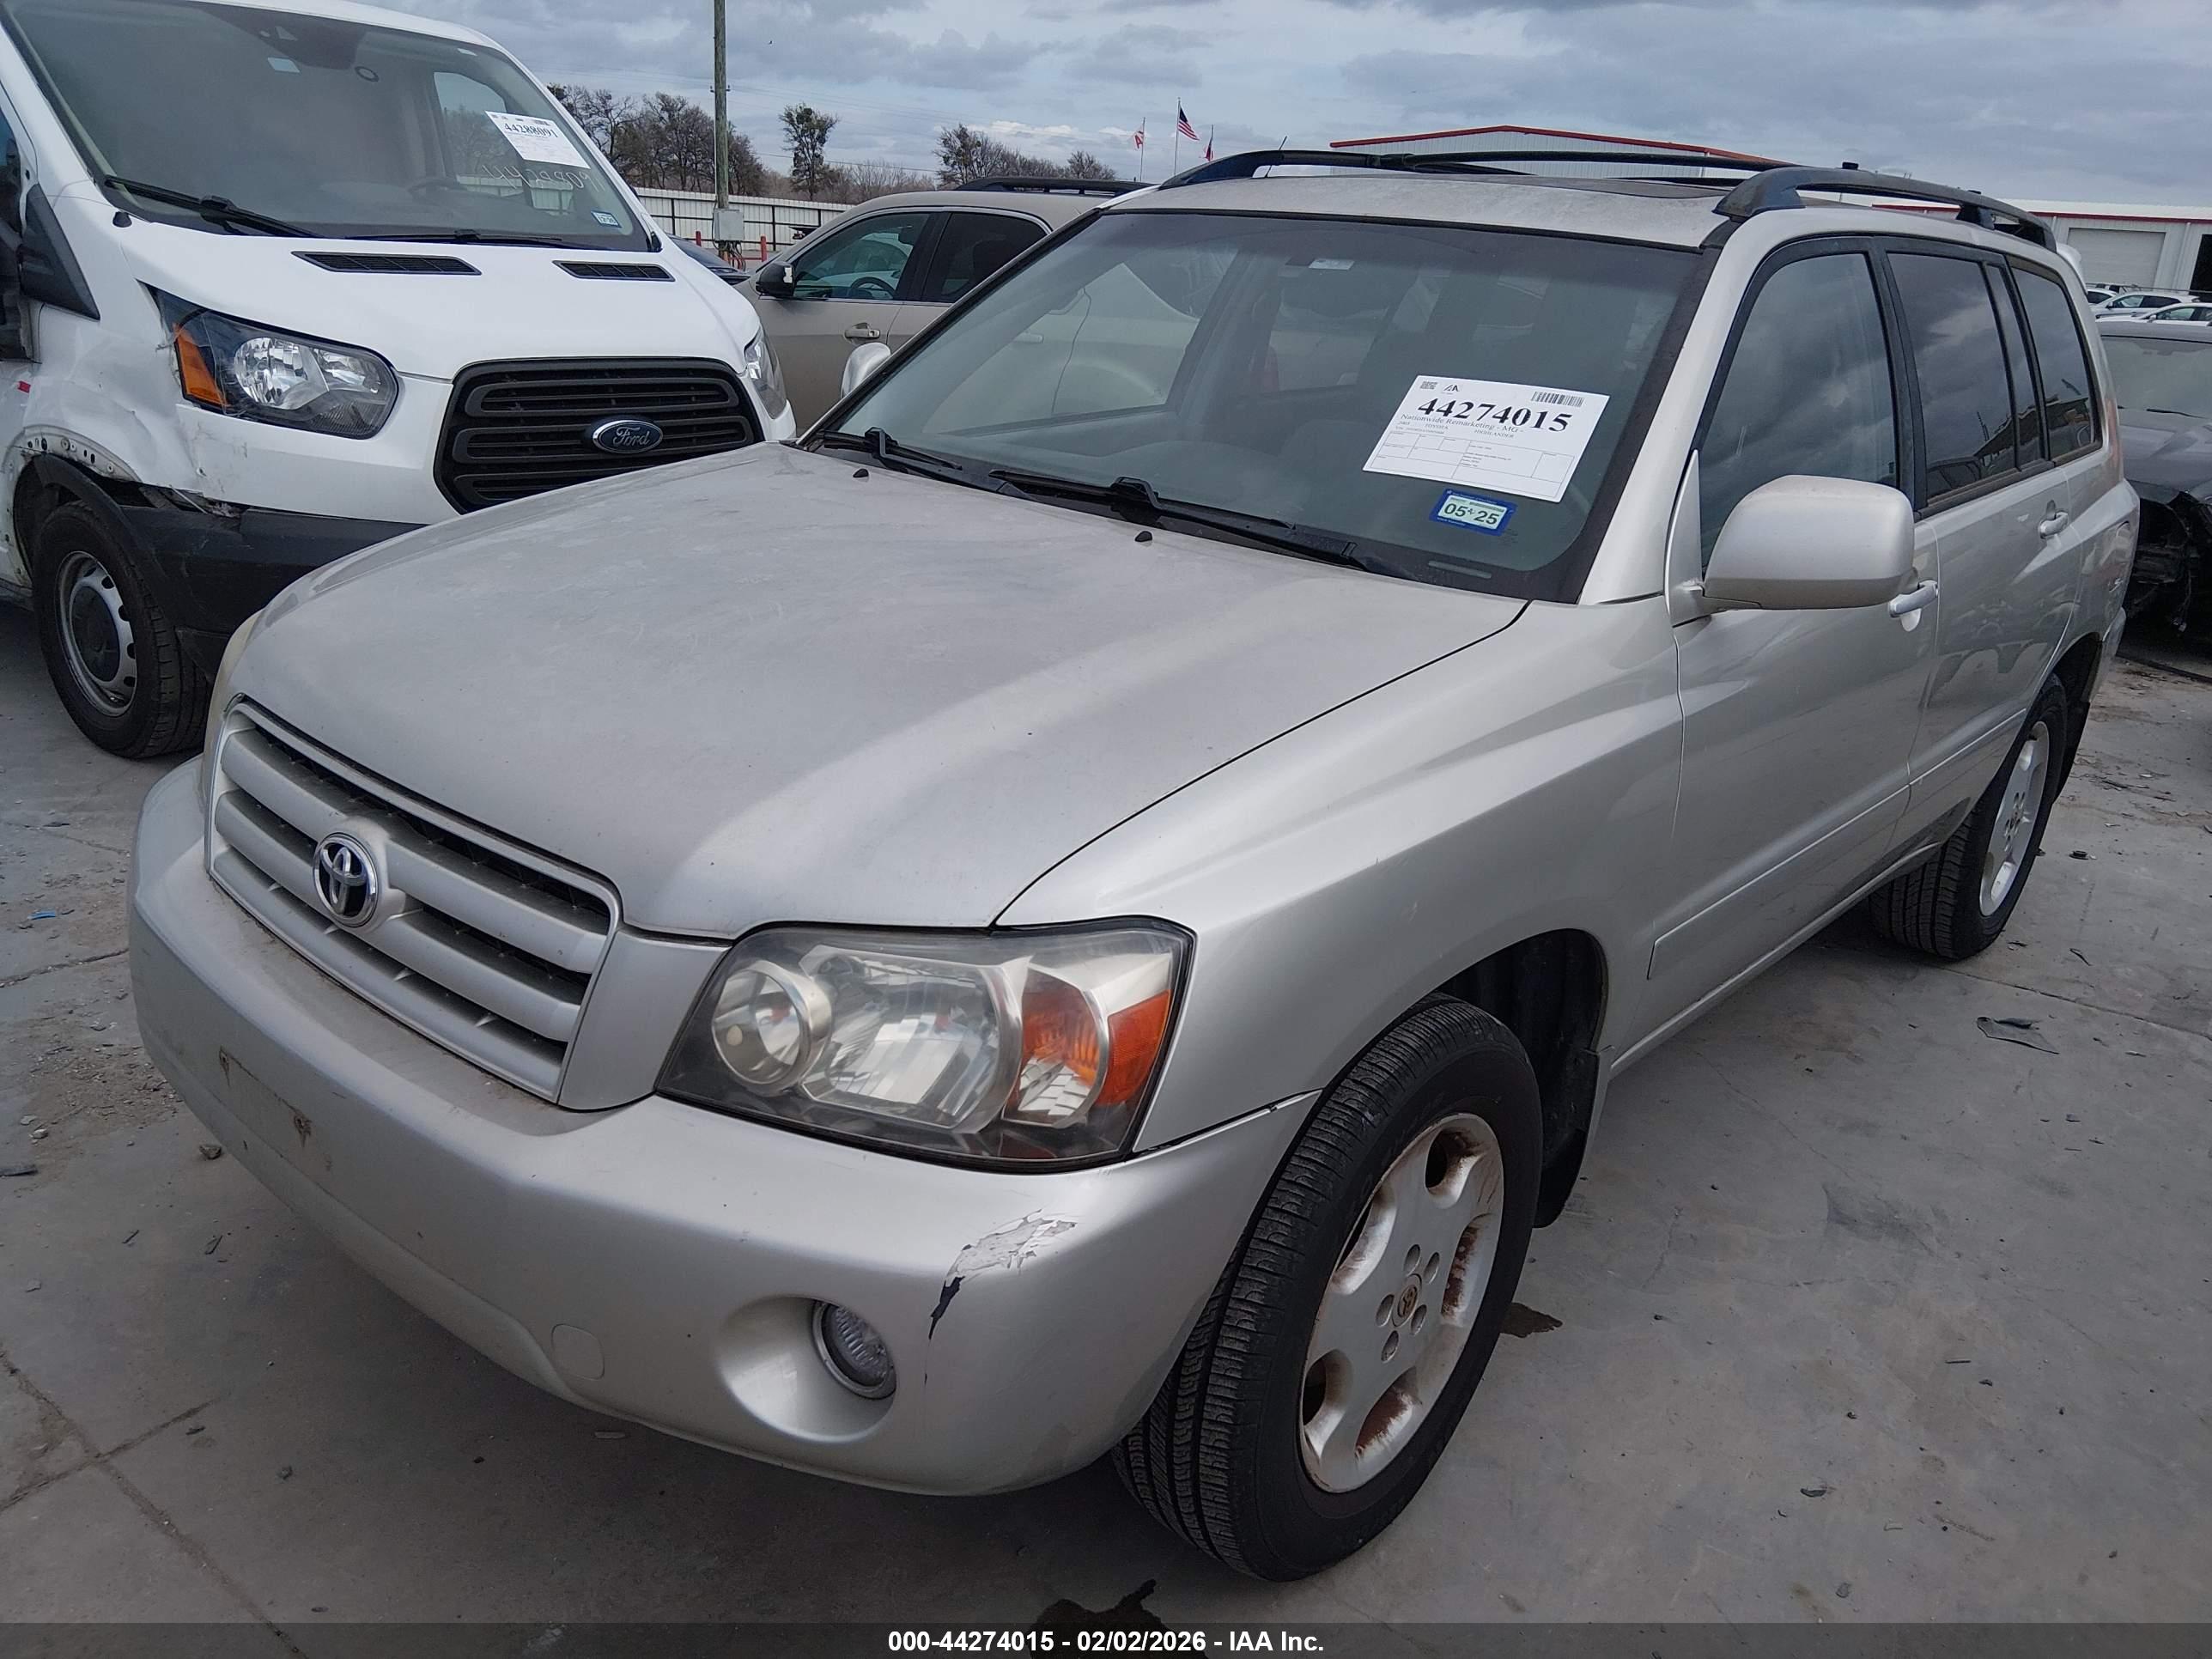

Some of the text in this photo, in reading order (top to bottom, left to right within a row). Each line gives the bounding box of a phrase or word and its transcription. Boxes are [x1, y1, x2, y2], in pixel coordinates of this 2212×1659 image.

[505, 123, 558, 138] 44288091
[1401, 414, 1443, 424] Nationwide
[1446, 419, 1495, 430] Remarketing
[1418, 398, 1572, 432] 44274015
[613, 427, 651, 447] Ford
[1443, 503, 1468, 517] 05
[1474, 510, 1500, 525] 25
